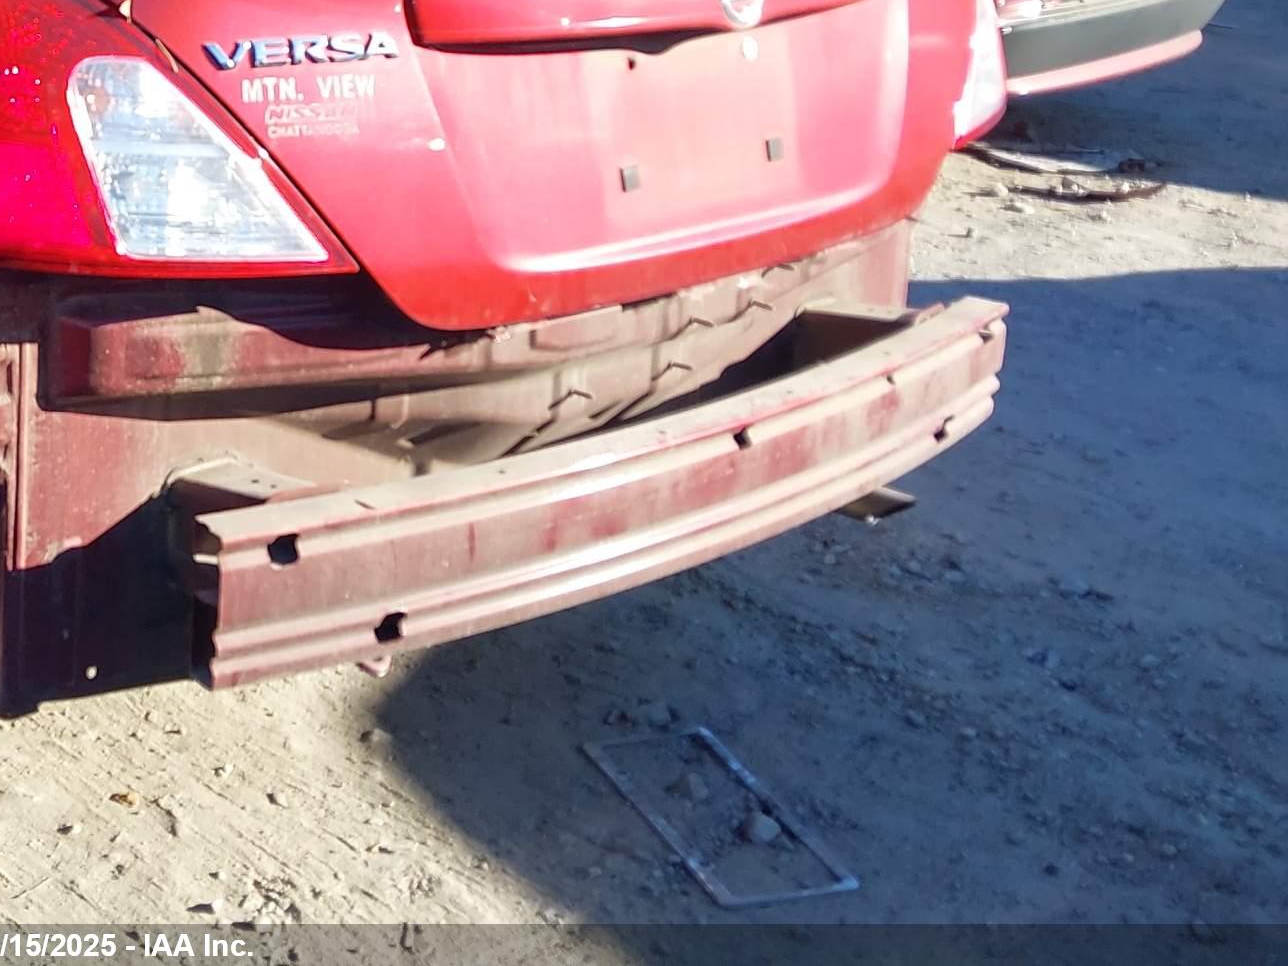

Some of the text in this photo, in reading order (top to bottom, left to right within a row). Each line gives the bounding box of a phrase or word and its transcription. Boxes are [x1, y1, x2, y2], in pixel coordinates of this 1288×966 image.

[202, 31, 401, 70] VERSA
[242, 72, 376, 104] MTN. VIEW
